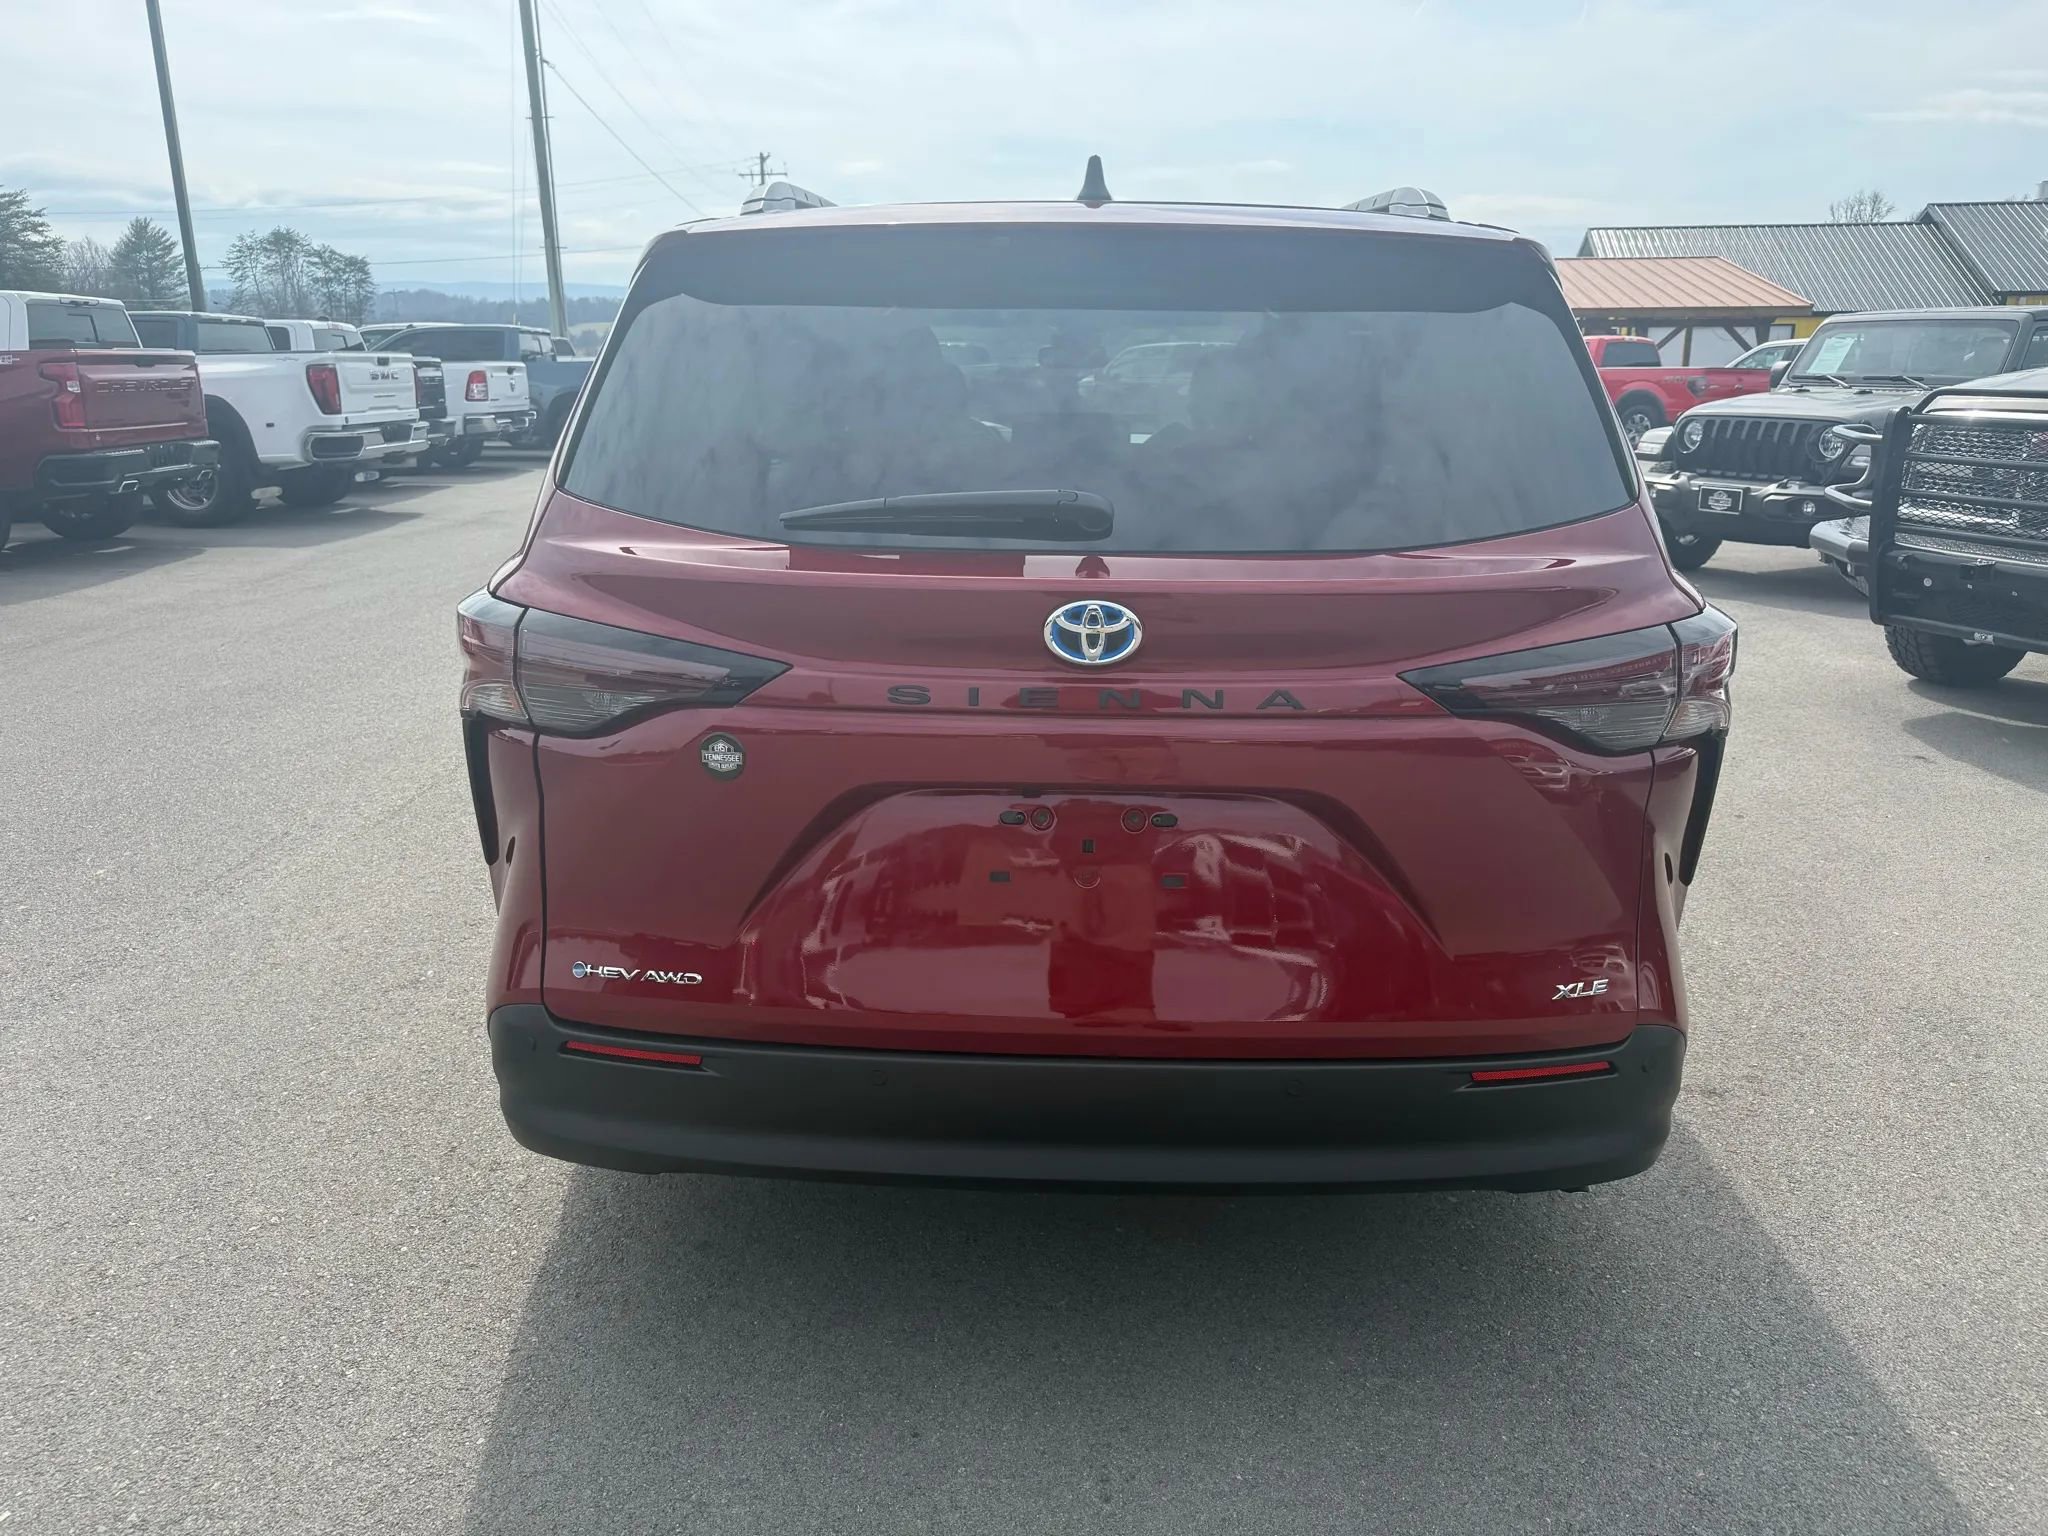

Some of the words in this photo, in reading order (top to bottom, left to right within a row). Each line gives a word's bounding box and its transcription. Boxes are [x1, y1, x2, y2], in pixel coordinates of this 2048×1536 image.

[887, 685, 1306, 711] SIENNA
[704, 753, 740, 762] TENNESSEE
[714, 743, 728, 752] EAST
[586, 964, 641, 981] HEV
[641, 970, 703, 984] AWD
[1551, 979, 1608, 1001] XLE
